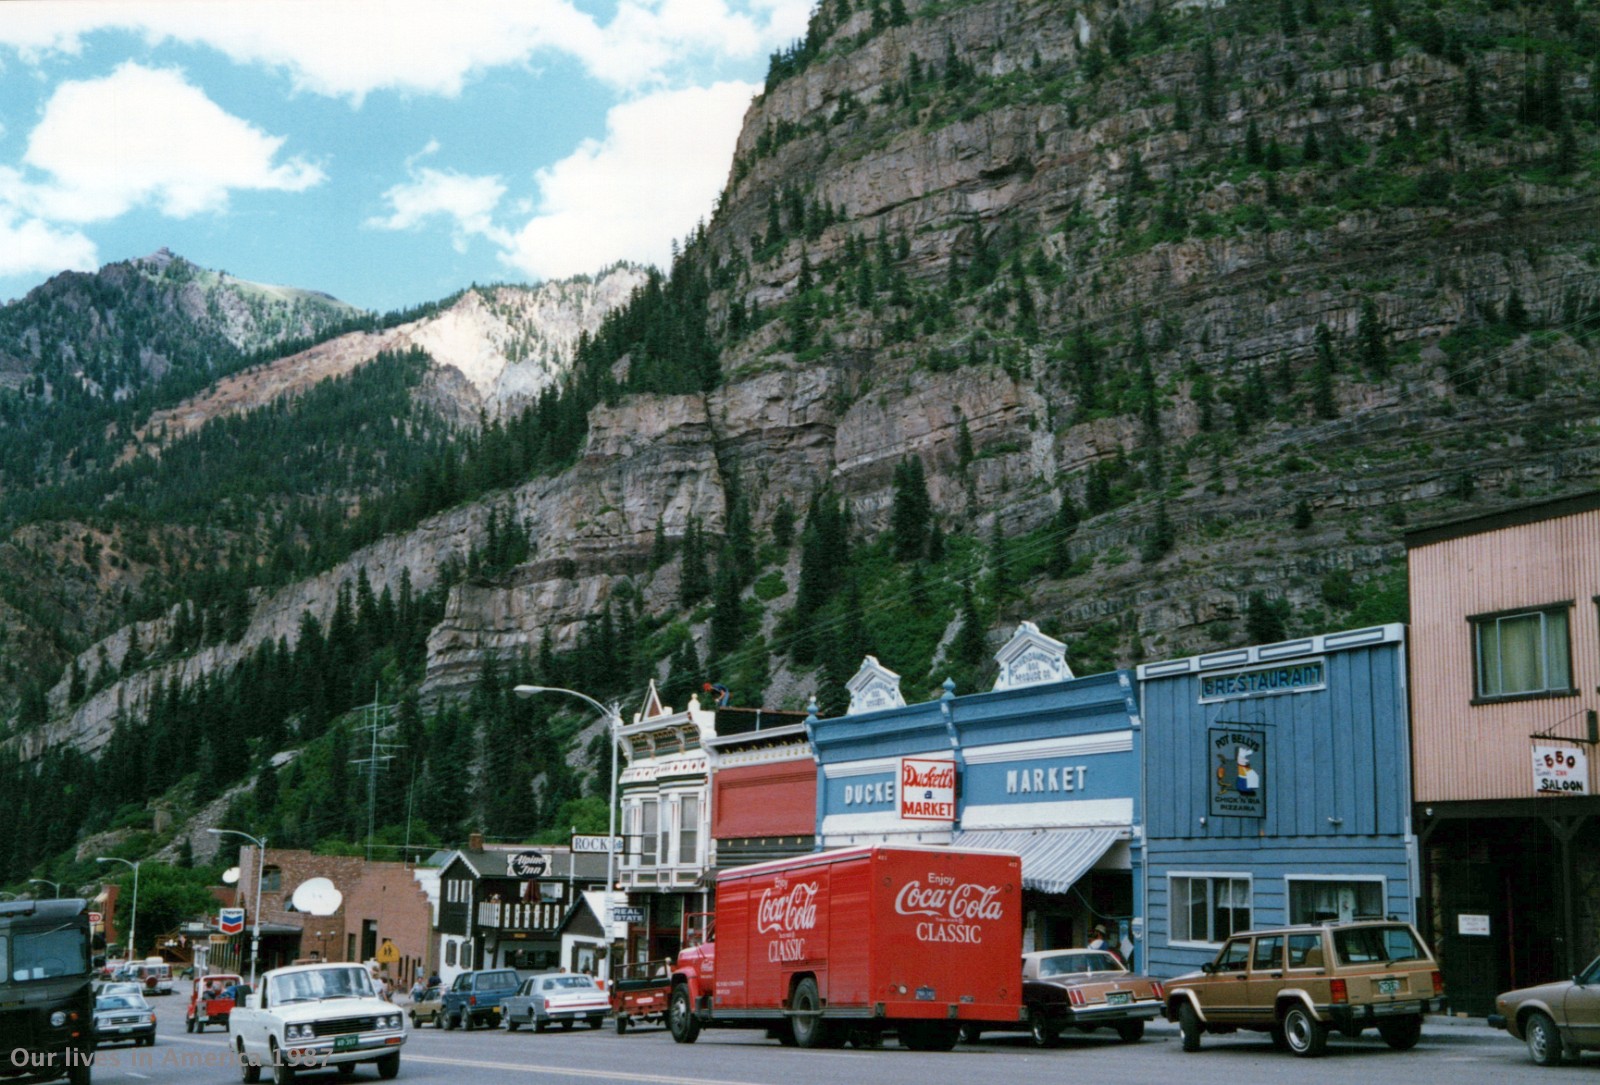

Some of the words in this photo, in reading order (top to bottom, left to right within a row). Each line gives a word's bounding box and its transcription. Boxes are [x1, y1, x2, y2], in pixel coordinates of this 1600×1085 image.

[1215, 735, 1229, 748] POT
[1544, 751, 1575, 768] 550
[904, 764, 953, 789] Duckett's
[1006, 766, 1087, 793] MARKET
[1541, 778, 1583, 792] SALOON
[903, 802, 953, 816] MARKET
[512, 854, 545, 866] Alpine
[518, 865, 542, 876] Inn
[928, 873, 955, 886] Enjoy
[916, 922, 982, 944] CLASSIC
[768, 938, 806, 963] CLASSIC
